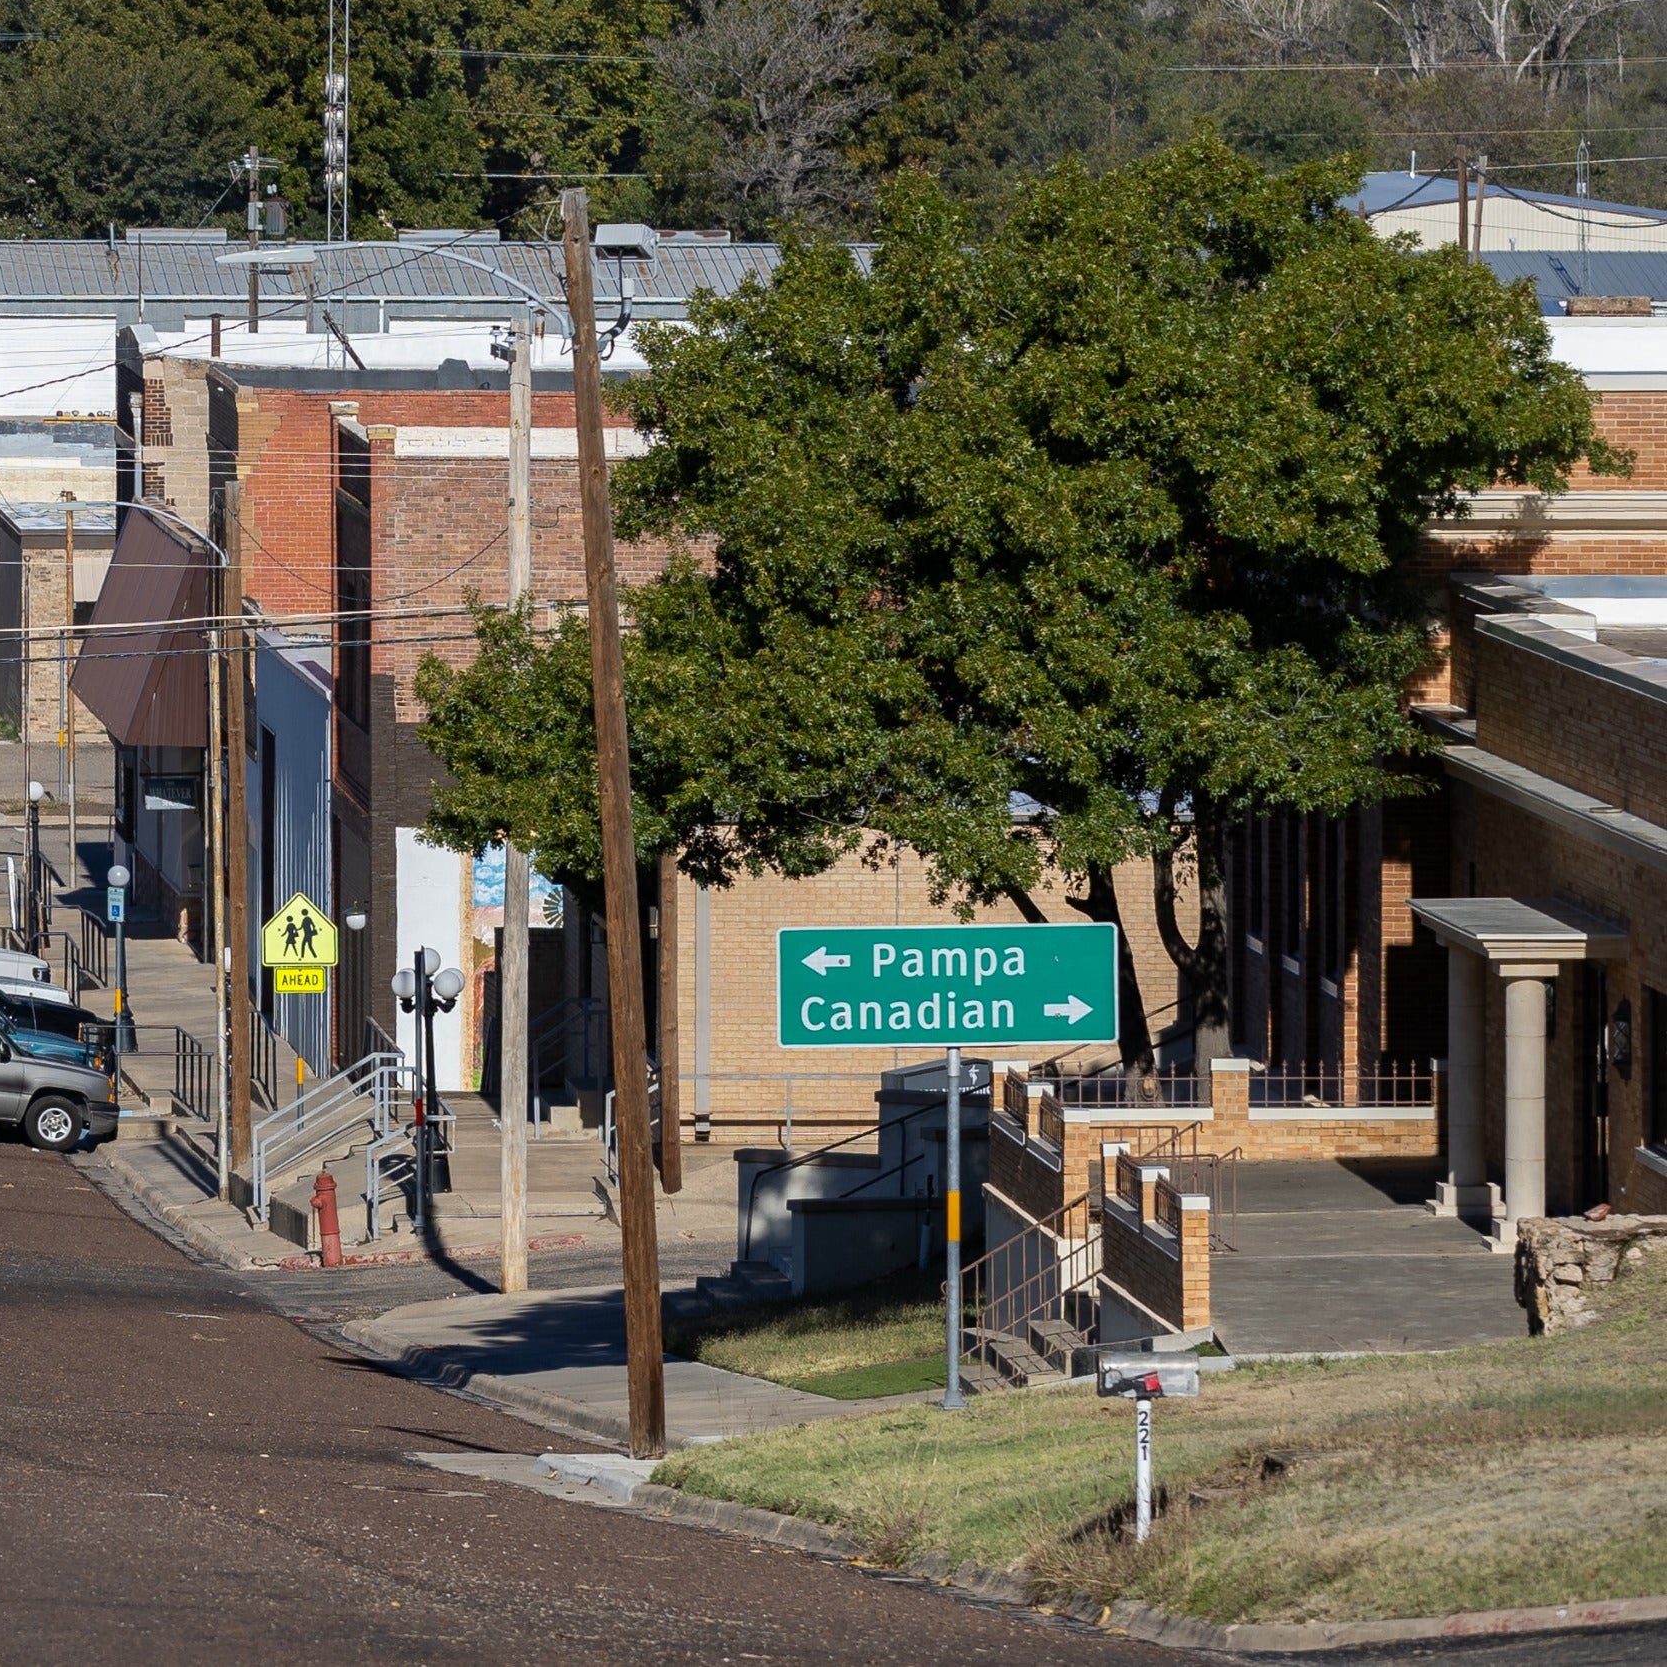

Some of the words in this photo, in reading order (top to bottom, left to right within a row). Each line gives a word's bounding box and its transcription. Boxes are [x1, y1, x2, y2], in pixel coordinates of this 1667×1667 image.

[149, 787, 192, 799] WHATEVER
[281, 974, 319, 986] AHEAD
[872, 942, 1026, 986] Pampa
[801, 991, 1015, 1031] Canadian
[1138, 1410, 1150, 1461] 221
